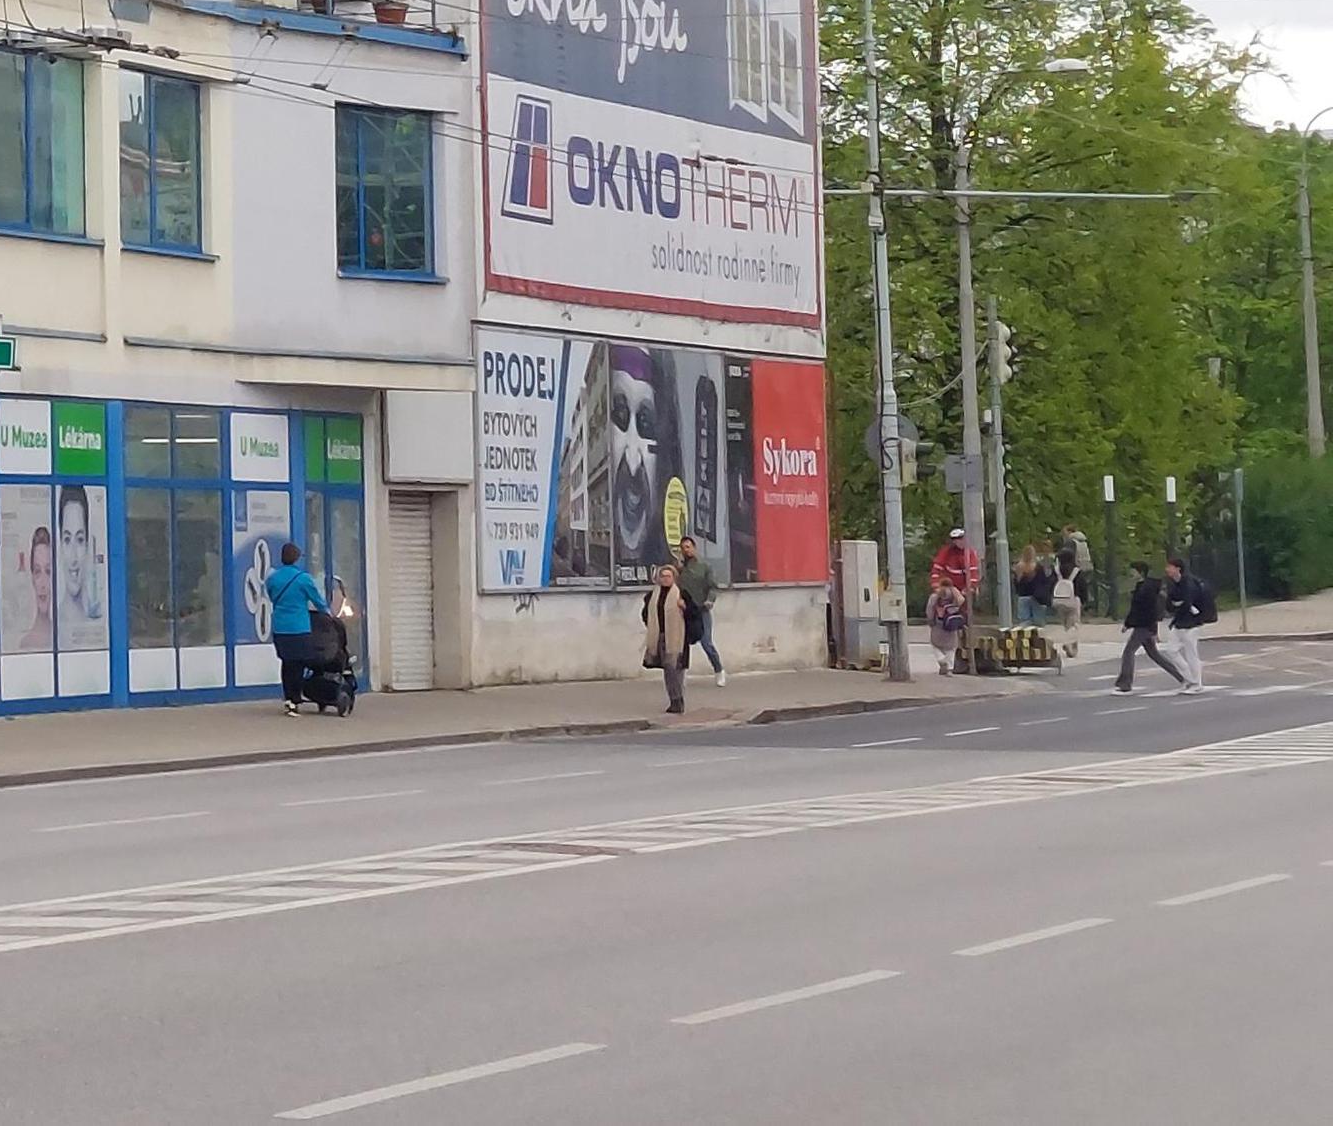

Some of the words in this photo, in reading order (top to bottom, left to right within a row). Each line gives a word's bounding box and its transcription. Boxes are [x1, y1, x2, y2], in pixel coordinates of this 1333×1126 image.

[567, 135, 801, 238] OKNOTHERM
[652, 230, 712, 277] solidnost
[717, 241, 767, 283] rodinné
[771, 244, 801, 298] firmy
[483, 351, 555, 401] PRODEJ
[0, 426, 8, 447] U
[12, 426, 48, 449] Muzea
[59, 425, 102, 450] Lékárna
[483, 408, 538, 438] BYTOVÝCH
[240, 436, 247, 457] U
[250, 436, 280, 458] Muzea
[484, 445, 538, 472] JEDNOTEK
[763, 437, 818, 484] Sykora
